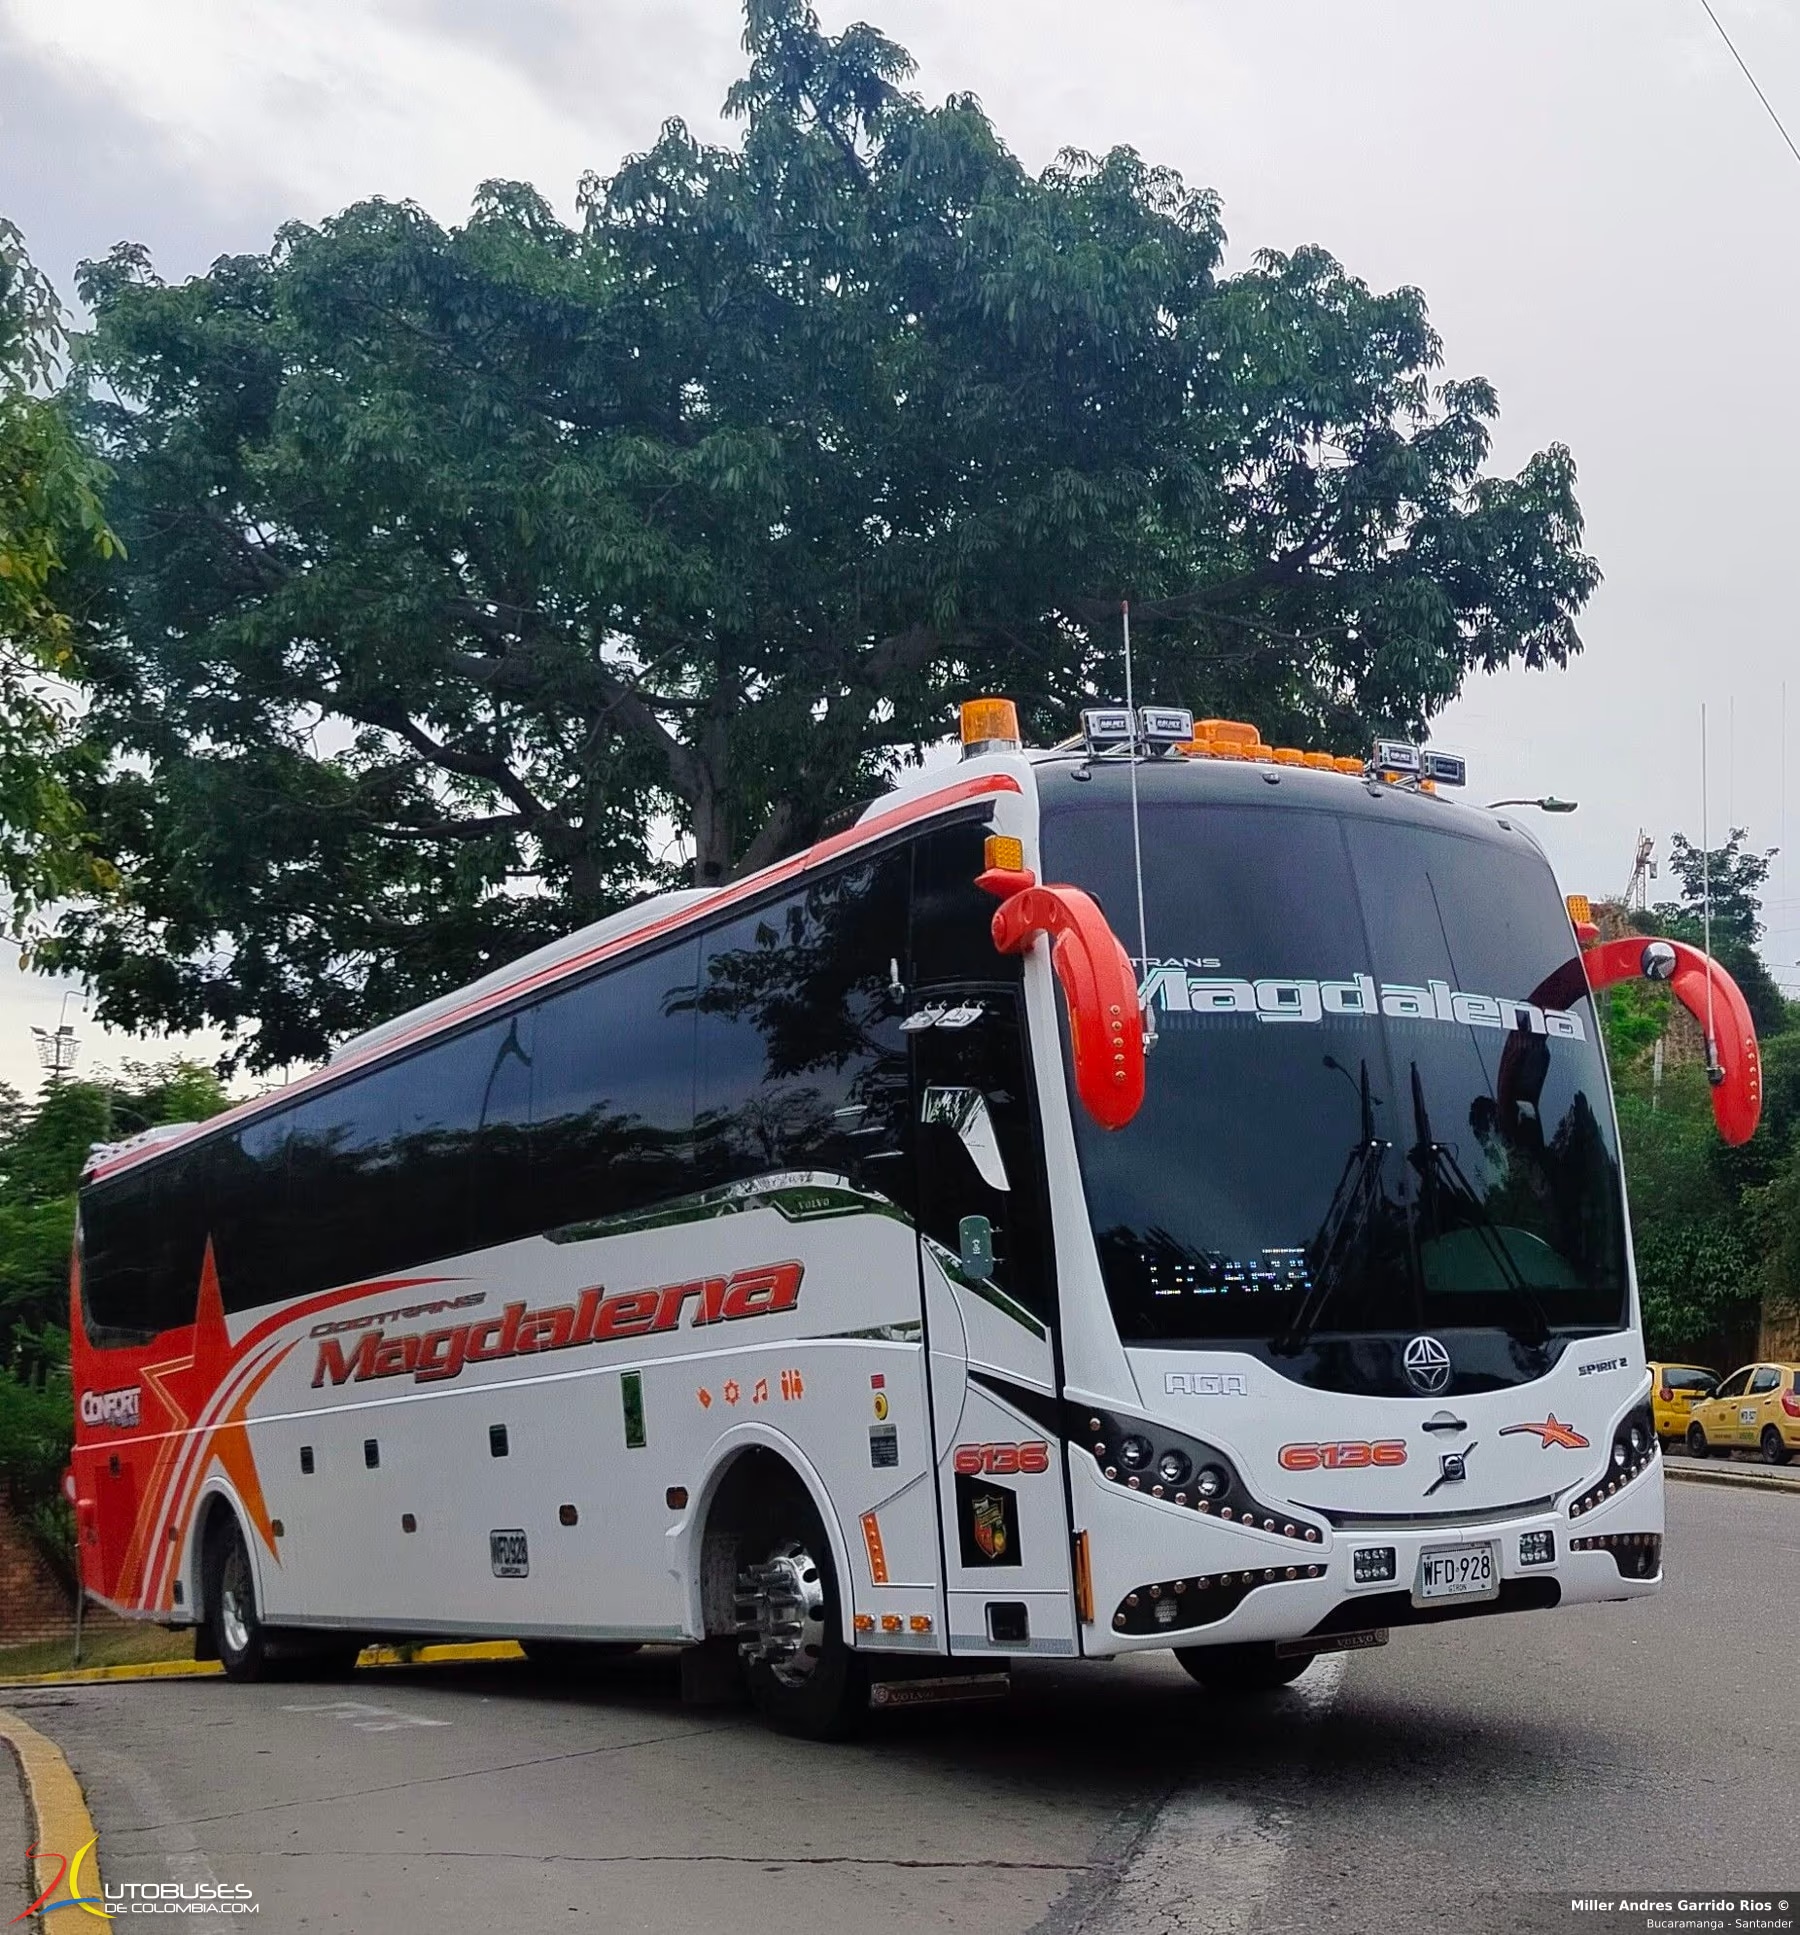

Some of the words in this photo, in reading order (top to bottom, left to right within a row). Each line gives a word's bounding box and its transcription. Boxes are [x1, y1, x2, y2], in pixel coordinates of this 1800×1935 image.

[1138, 967, 1587, 1042] Magdalena
[311, 1259, 805, 1387] Magdalena
[1578, 1360, 1618, 1376] SPIRIT
[1619, 1357, 1628, 1367] 2
[1165, 1372, 1248, 1396] AGA
[954, 1440, 1049, 1476] 6136
[1278, 1439, 1407, 1471] 6136
